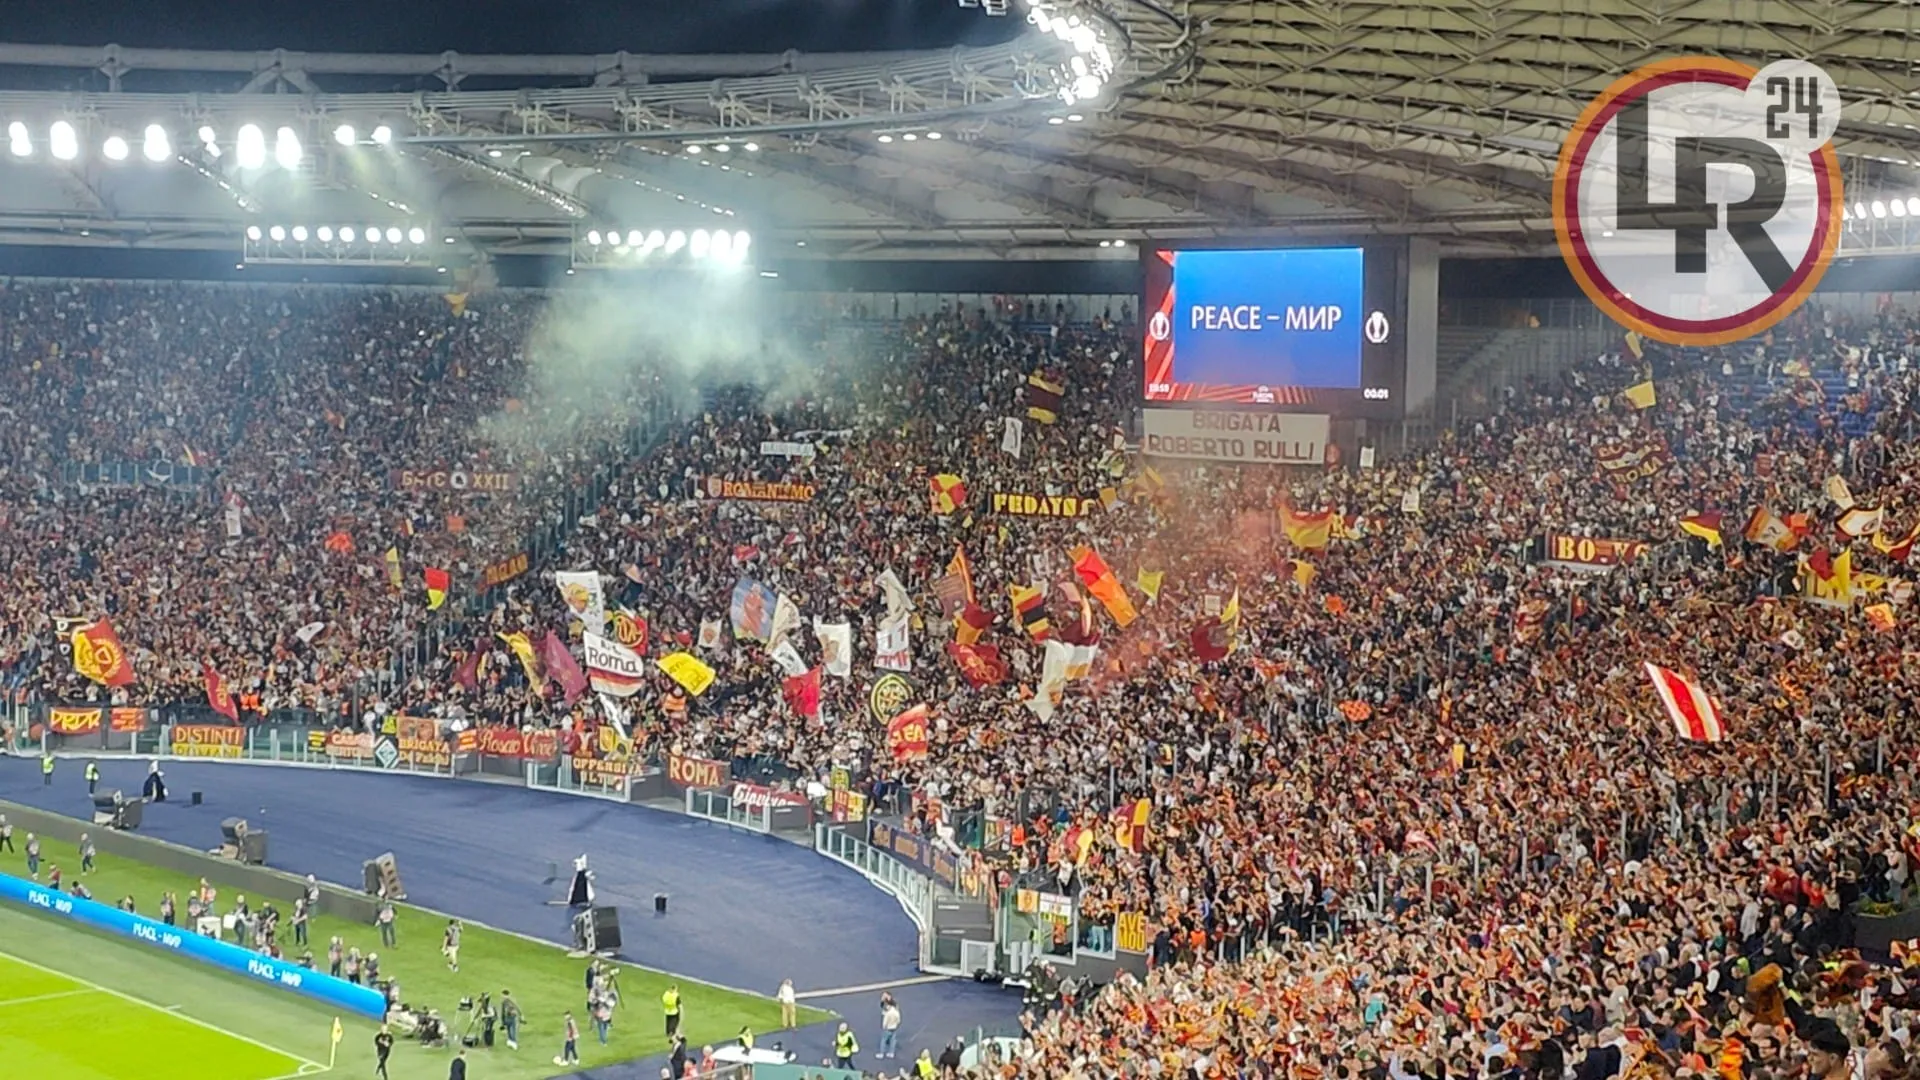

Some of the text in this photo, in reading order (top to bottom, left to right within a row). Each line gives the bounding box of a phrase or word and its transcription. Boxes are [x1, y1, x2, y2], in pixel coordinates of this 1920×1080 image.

[1191, 305, 1262, 330] PEACE
[1285, 305, 1342, 330] МИР
[1192, 411, 1281, 433] BRIGATA
[1148, 434, 1314, 460] ROBERTO RULLI
[993, 493, 1077, 516] FEDAYN
[588, 646, 640, 674] Roma
[176, 726, 240, 745] DISTINTI
[669, 756, 720, 787] ROMA
